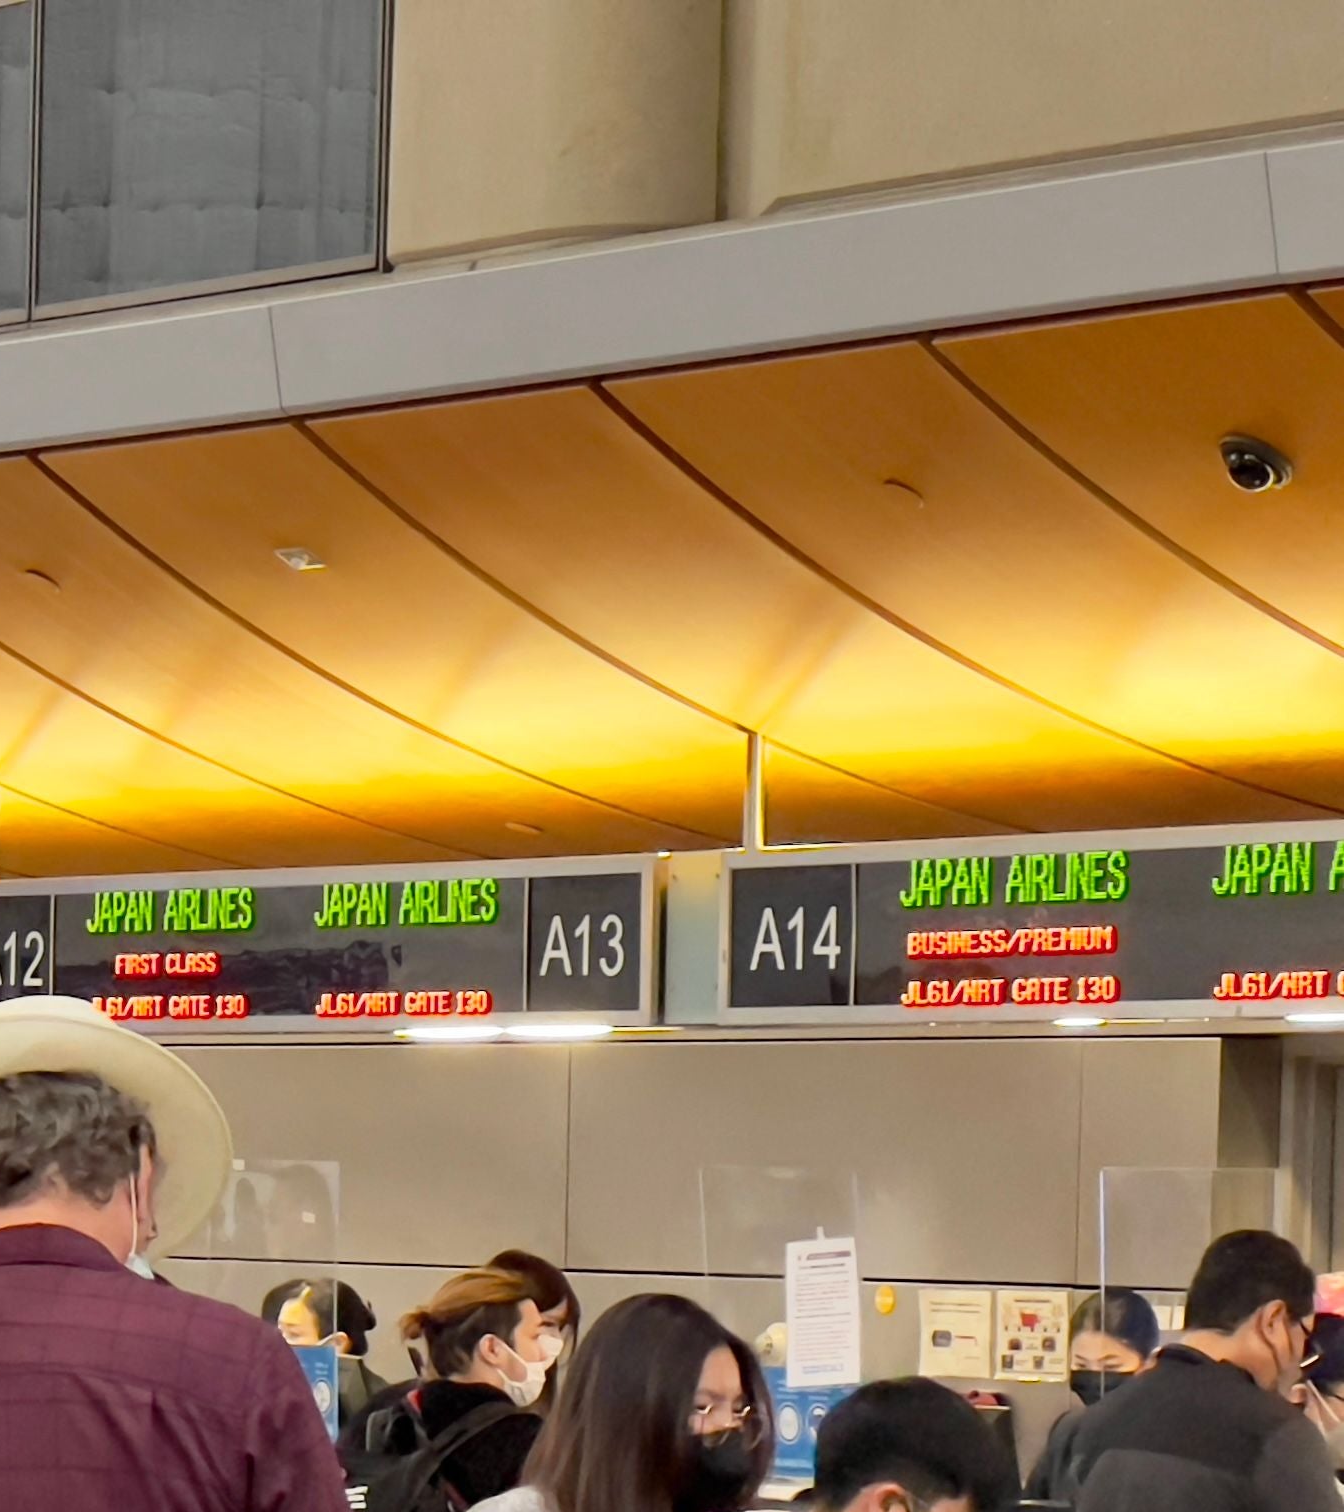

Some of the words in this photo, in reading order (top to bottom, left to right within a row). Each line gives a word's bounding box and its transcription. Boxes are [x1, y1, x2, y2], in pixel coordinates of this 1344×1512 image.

[900, 857, 990, 907] JAPAN
[1006, 849, 1128, 903] AIRLINES
[1211, 842, 1312, 895] JAPAN
[86, 892, 153, 933] JAPAN
[164, 887, 253, 930] AIRLINES
[314, 883, 386, 927] JAPAN
[399, 877, 497, 924] AIRLINES
[539, 914, 625, 977] A13
[749, 906, 842, 971] A14
[907, 925, 1113, 956] BUSINESS/PREMIUM
[115, 953, 160, 975] FIRST
[165, 952, 217, 974] CLASS
[404, 991, 451, 1014] GATE
[455, 990, 487, 1013] 130
[901, 978, 1006, 1006] JL61/NRT
[1011, 976, 1069, 1004] GATE
[1076, 975, 1116, 1002] 130
